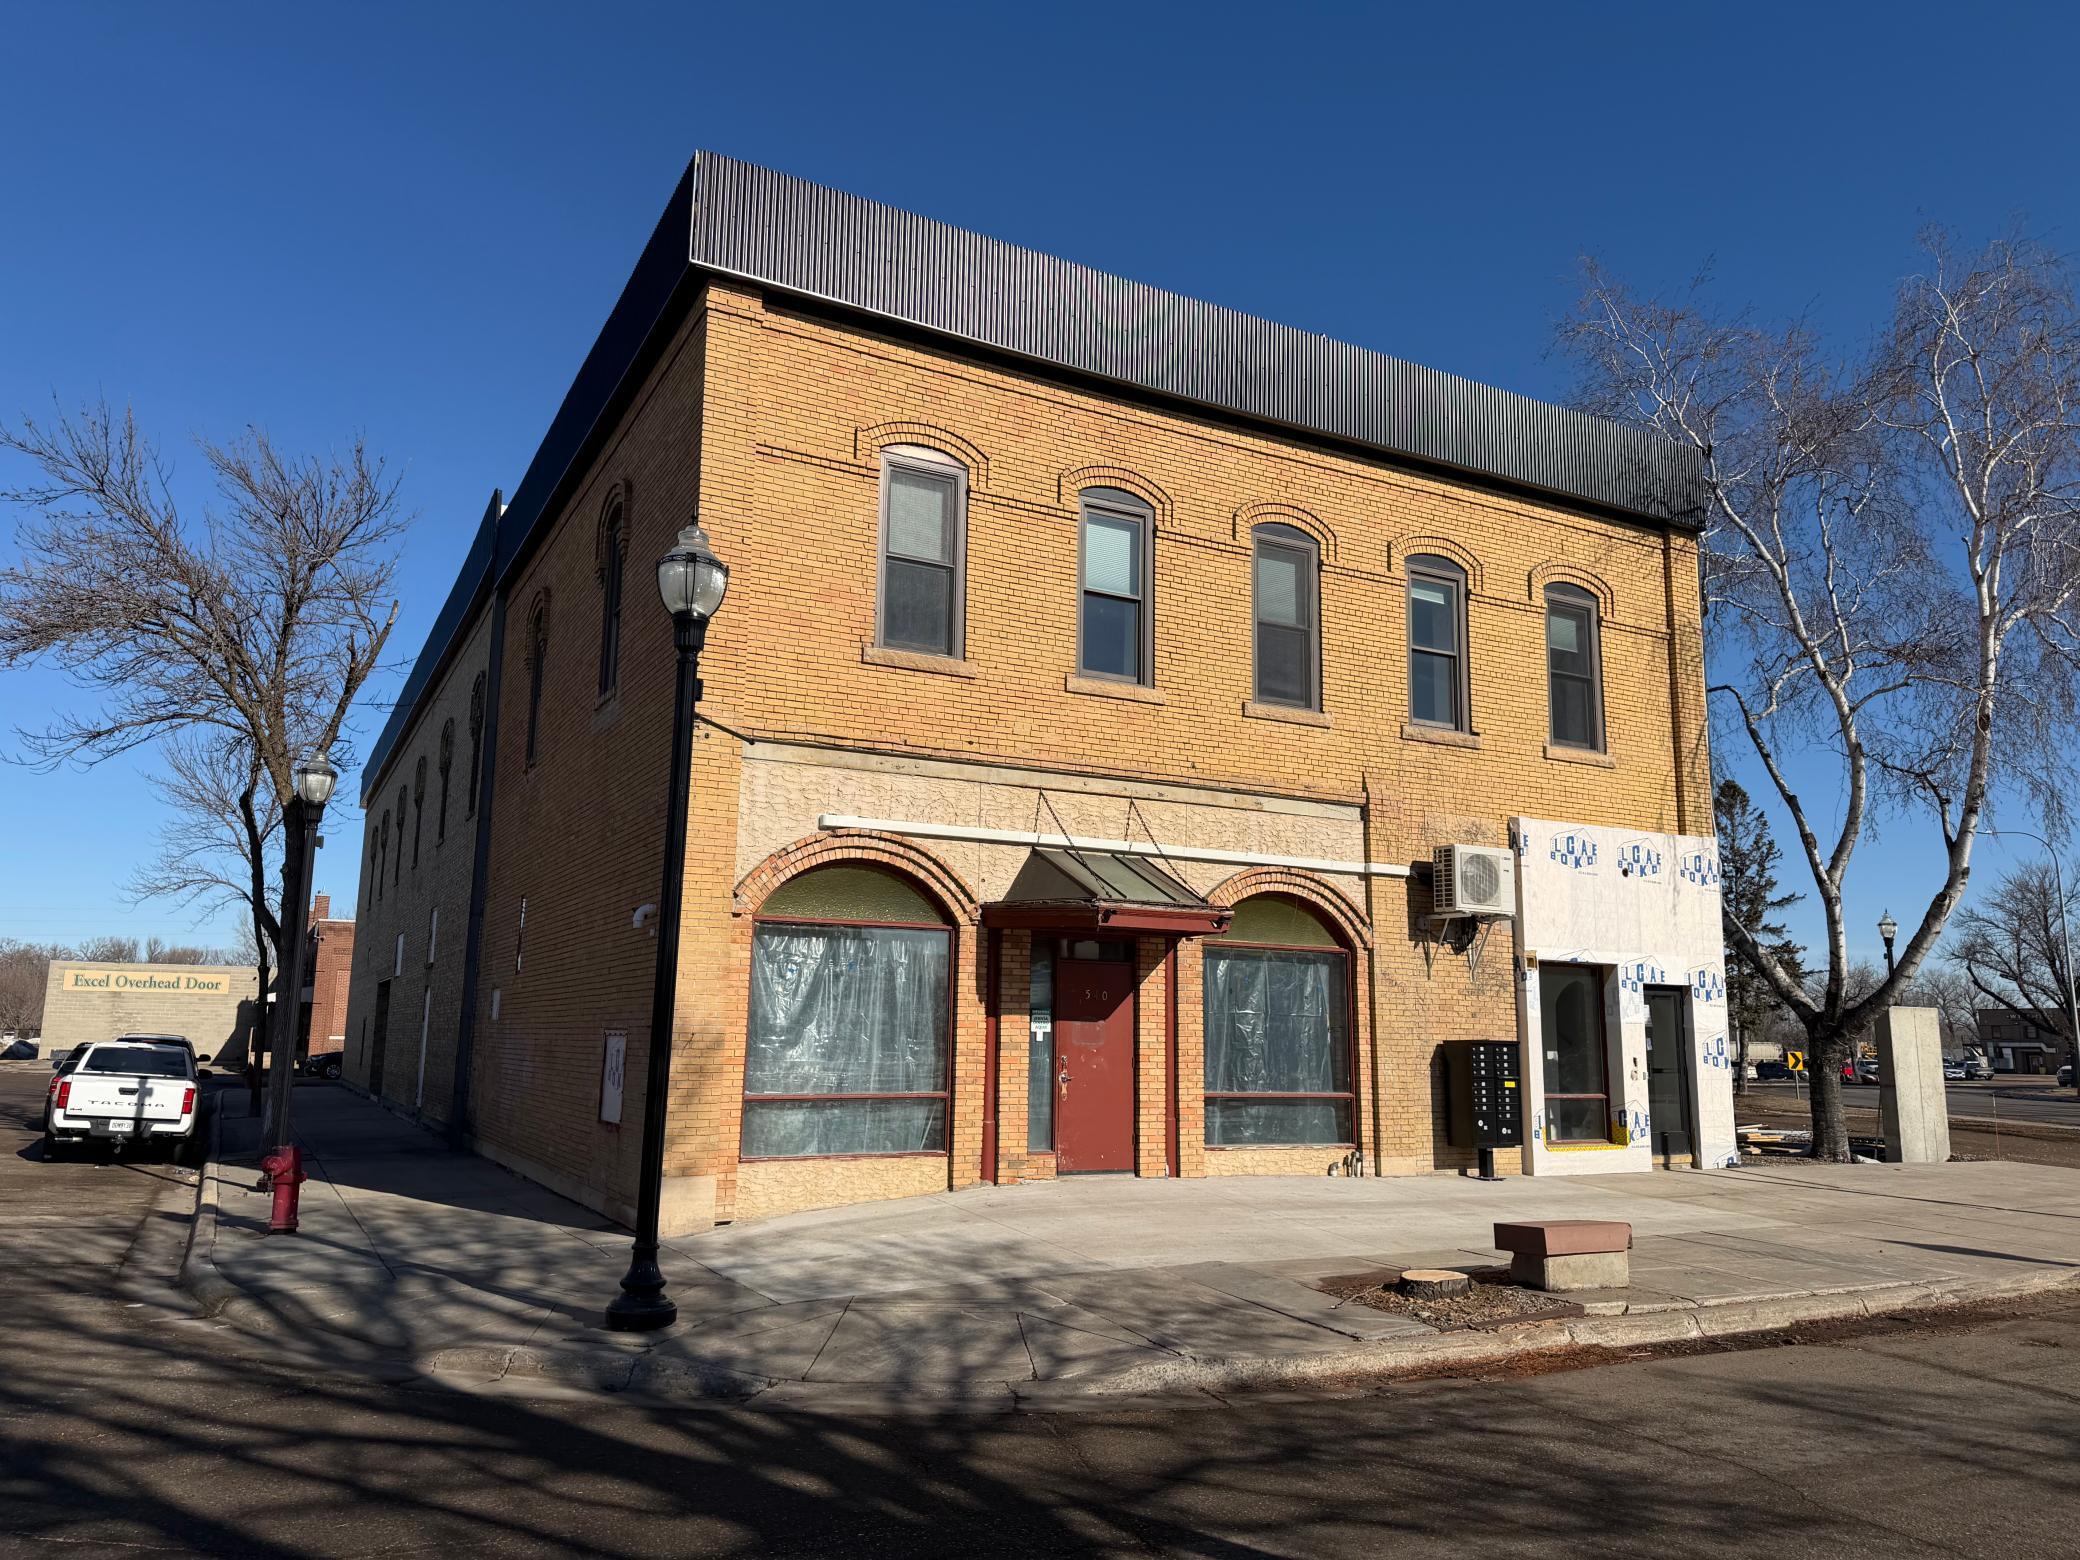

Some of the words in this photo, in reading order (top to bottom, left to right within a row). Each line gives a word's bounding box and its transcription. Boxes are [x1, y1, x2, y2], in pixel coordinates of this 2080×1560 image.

[72, 973, 111, 987] Excel
[115, 975, 181, 989] Overhead
[184, 976, 222, 990] Door
[88, 1099, 165, 1108] TACOMA
